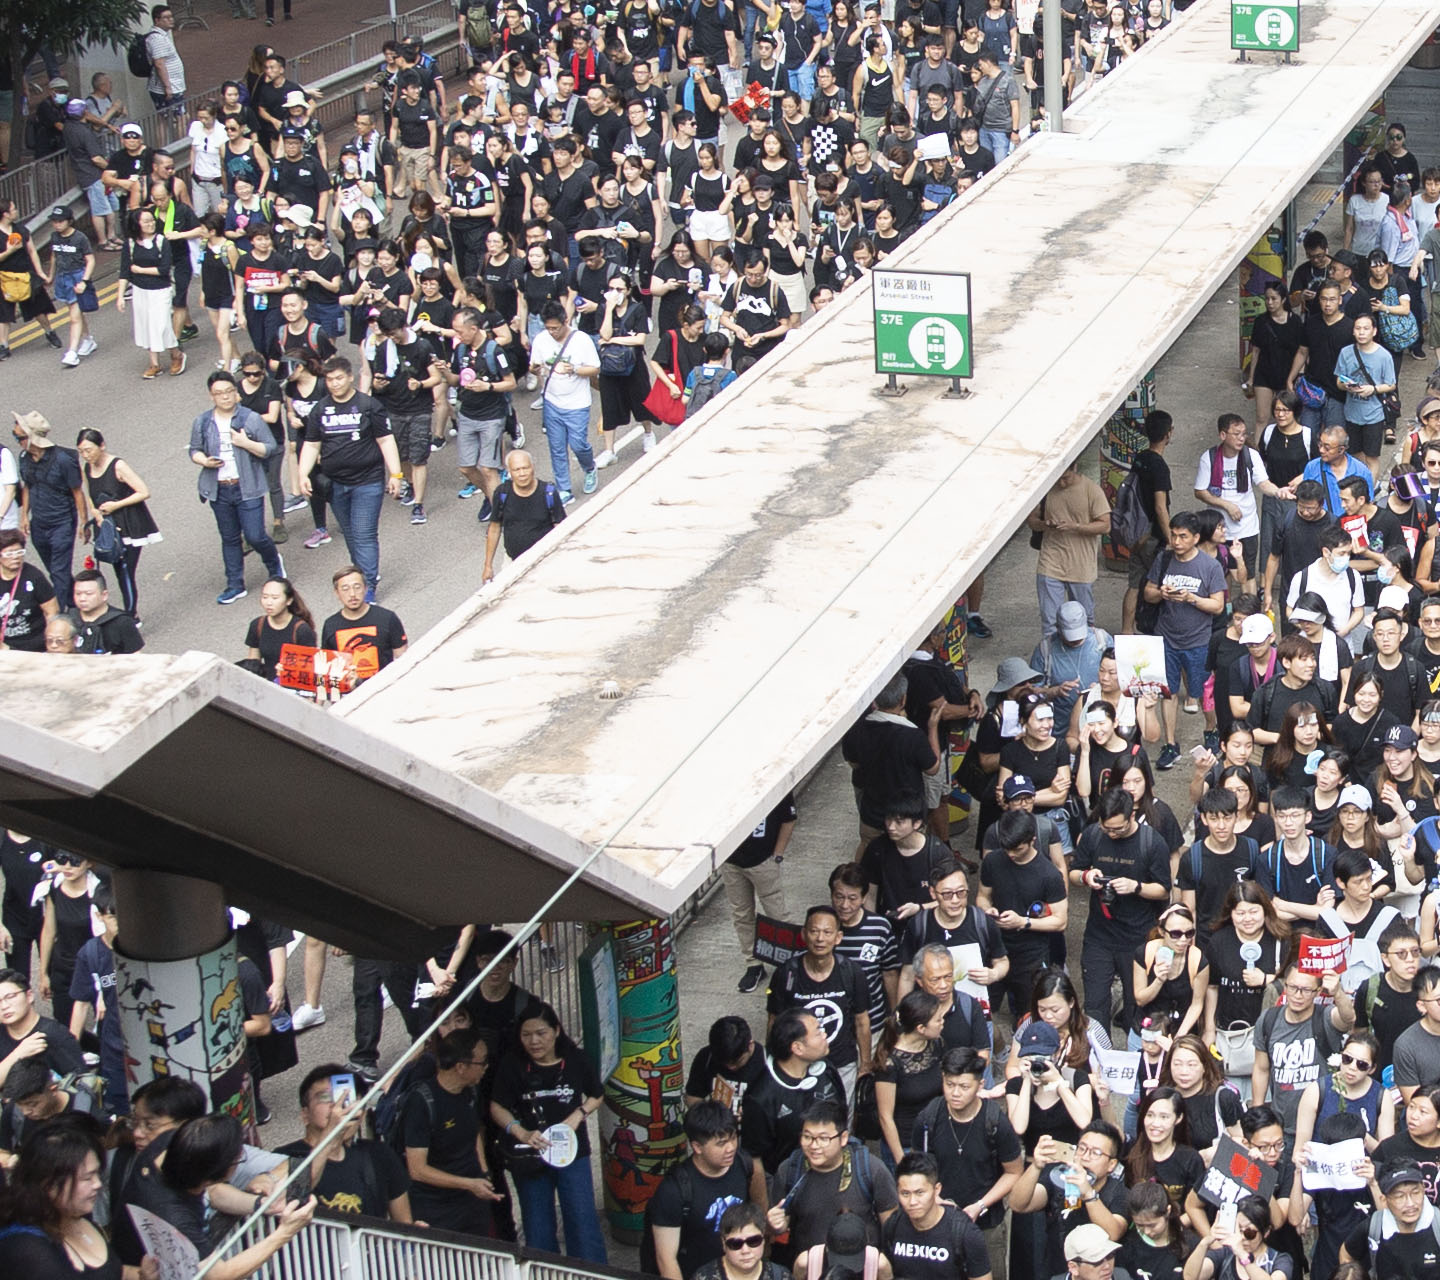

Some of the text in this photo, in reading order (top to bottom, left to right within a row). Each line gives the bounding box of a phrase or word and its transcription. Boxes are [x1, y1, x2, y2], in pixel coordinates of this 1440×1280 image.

[1236, 5, 1252, 15] 37E
[910, 294, 934, 302] Street
[881, 313, 903, 326] 37E
[882, 360, 916, 370] Eastbound
[285, 651, 312, 666] 孩子
[1388, 726, 1401, 741] NY
[895, 1241, 949, 1261] MEXICO
